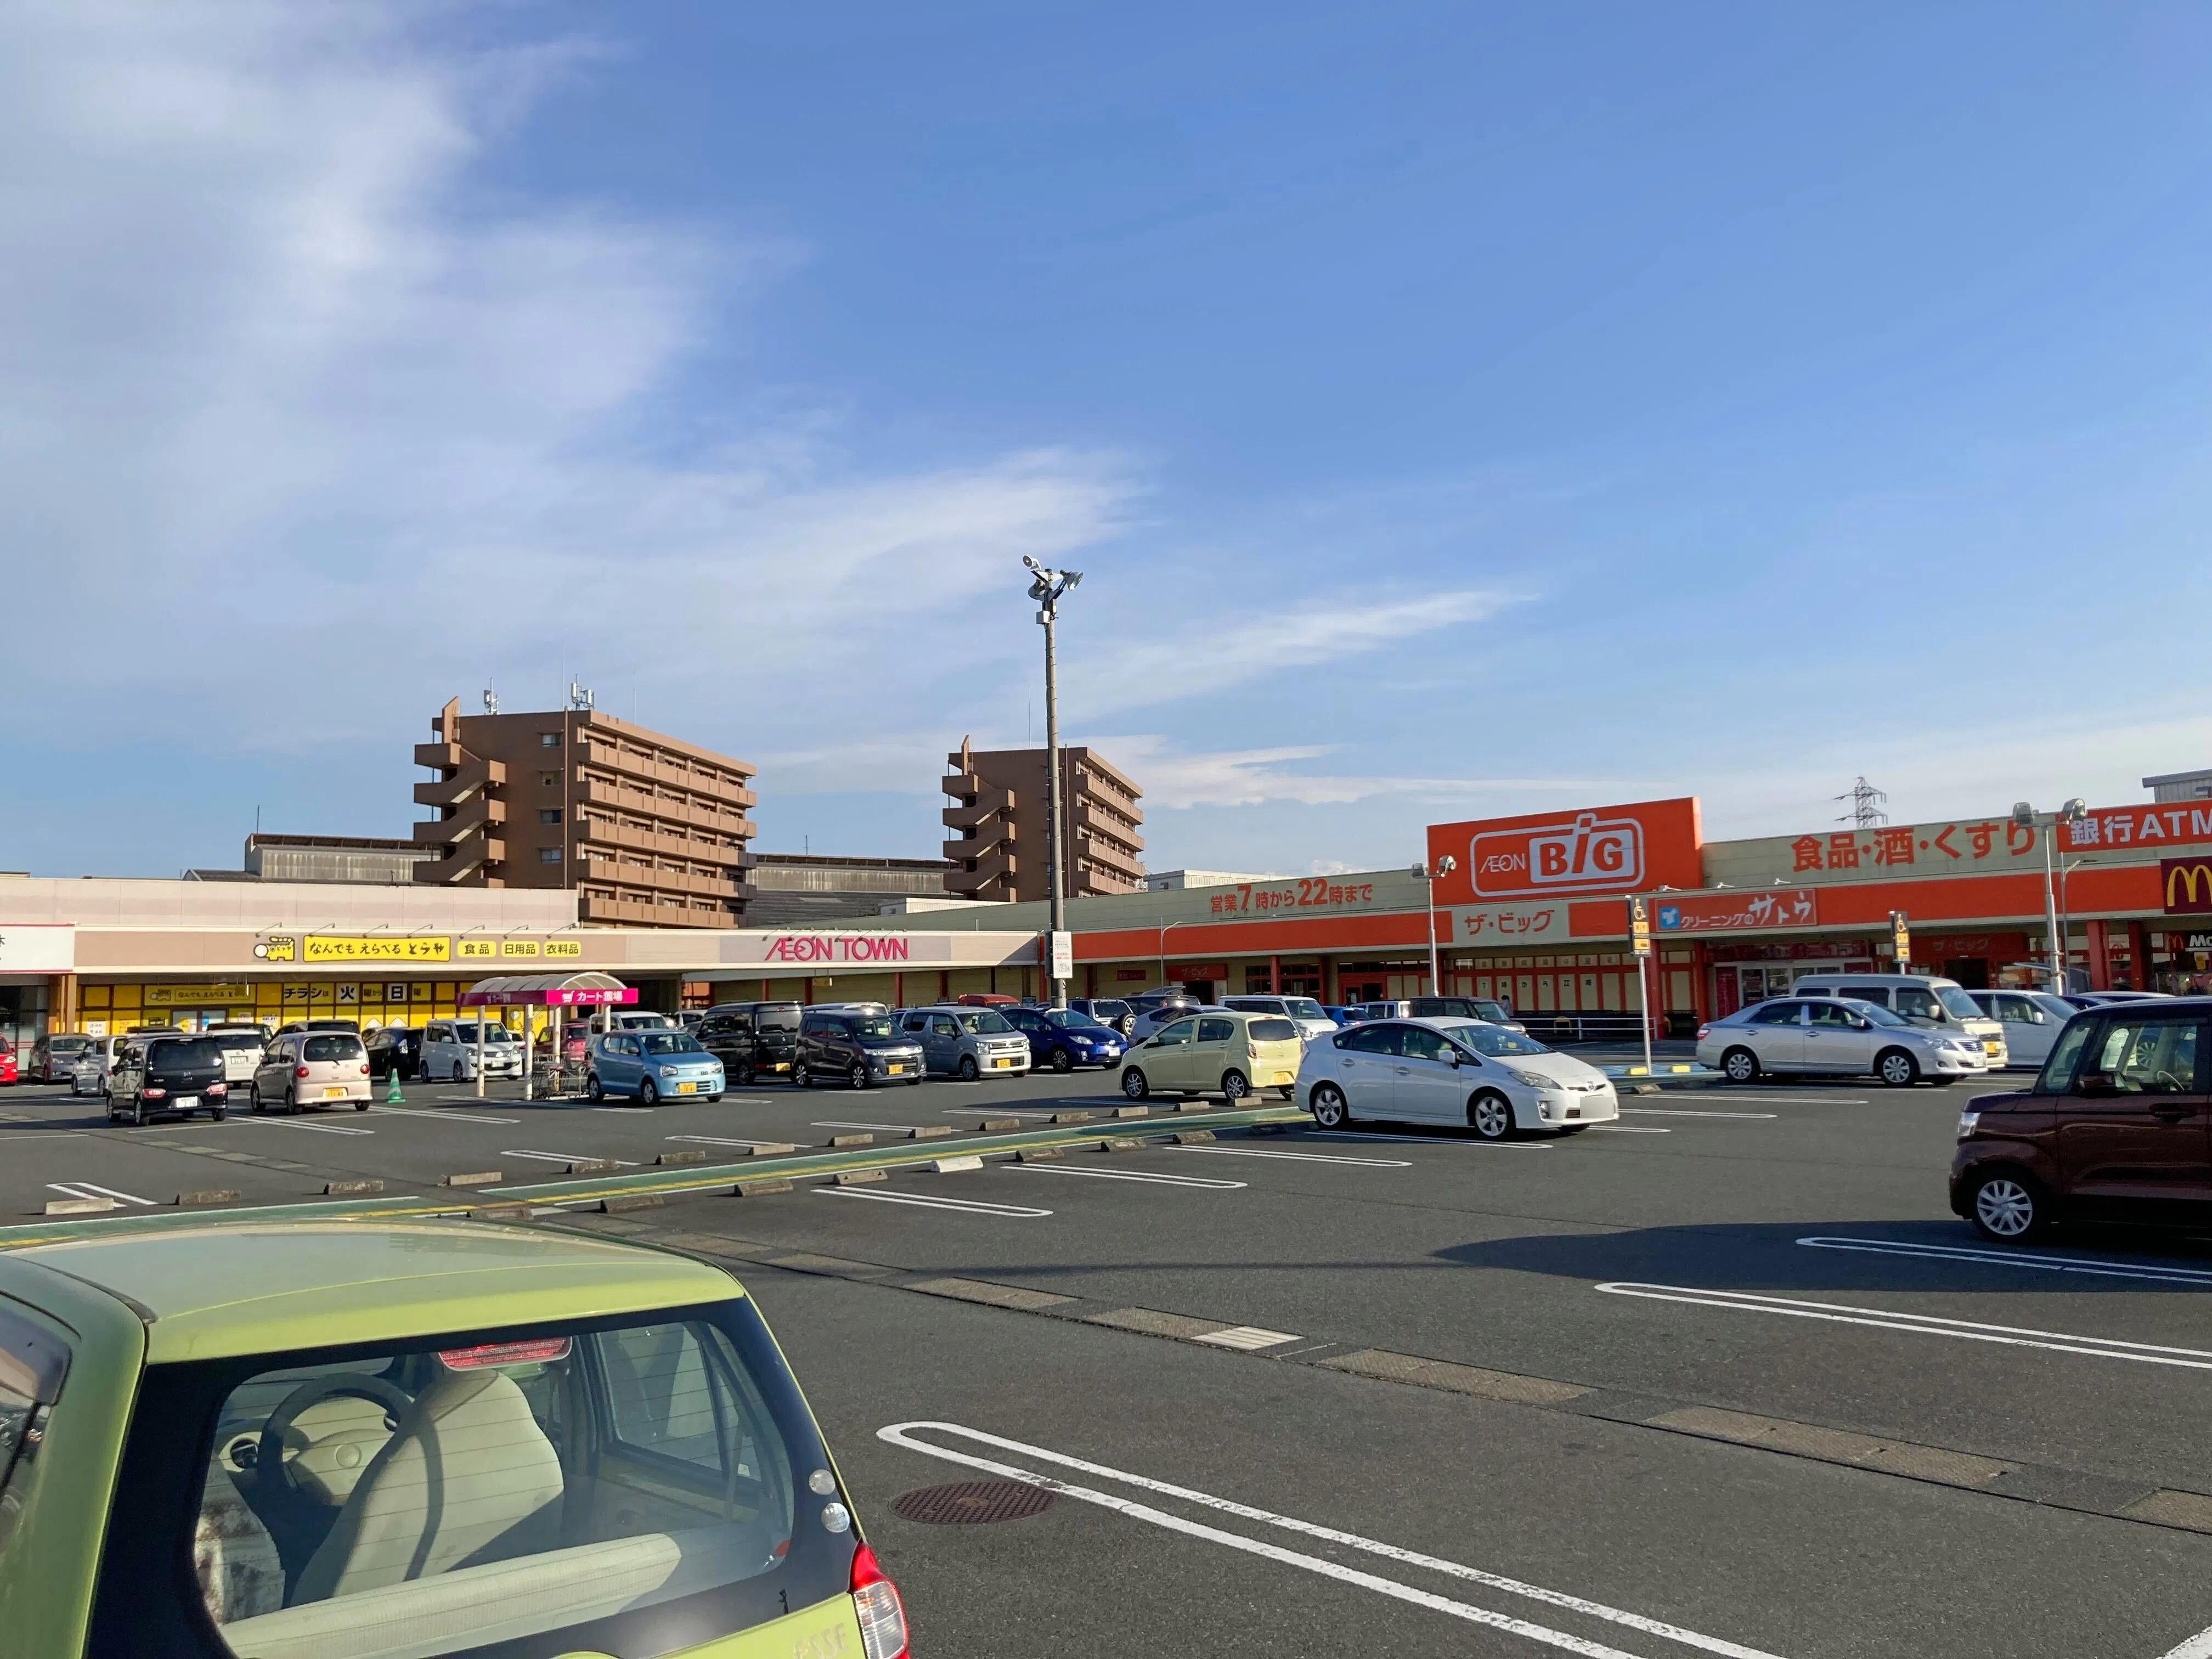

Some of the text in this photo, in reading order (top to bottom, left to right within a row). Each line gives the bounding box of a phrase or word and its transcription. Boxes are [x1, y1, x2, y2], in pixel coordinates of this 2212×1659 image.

[2070, 809, 2212, 845] 銀行ATM
[1210, 878, 1374, 913] 営業7時から22時まで
[1464, 909, 1555, 935] ザ・ビッグ
[309, 943, 444, 955] なんでも えらべる とらや
[465, 943, 489, 955] 食品
[505, 943, 536, 955] 日用品
[546, 943, 579, 955] 衣料品
[839, 937, 908, 961] TOWN
